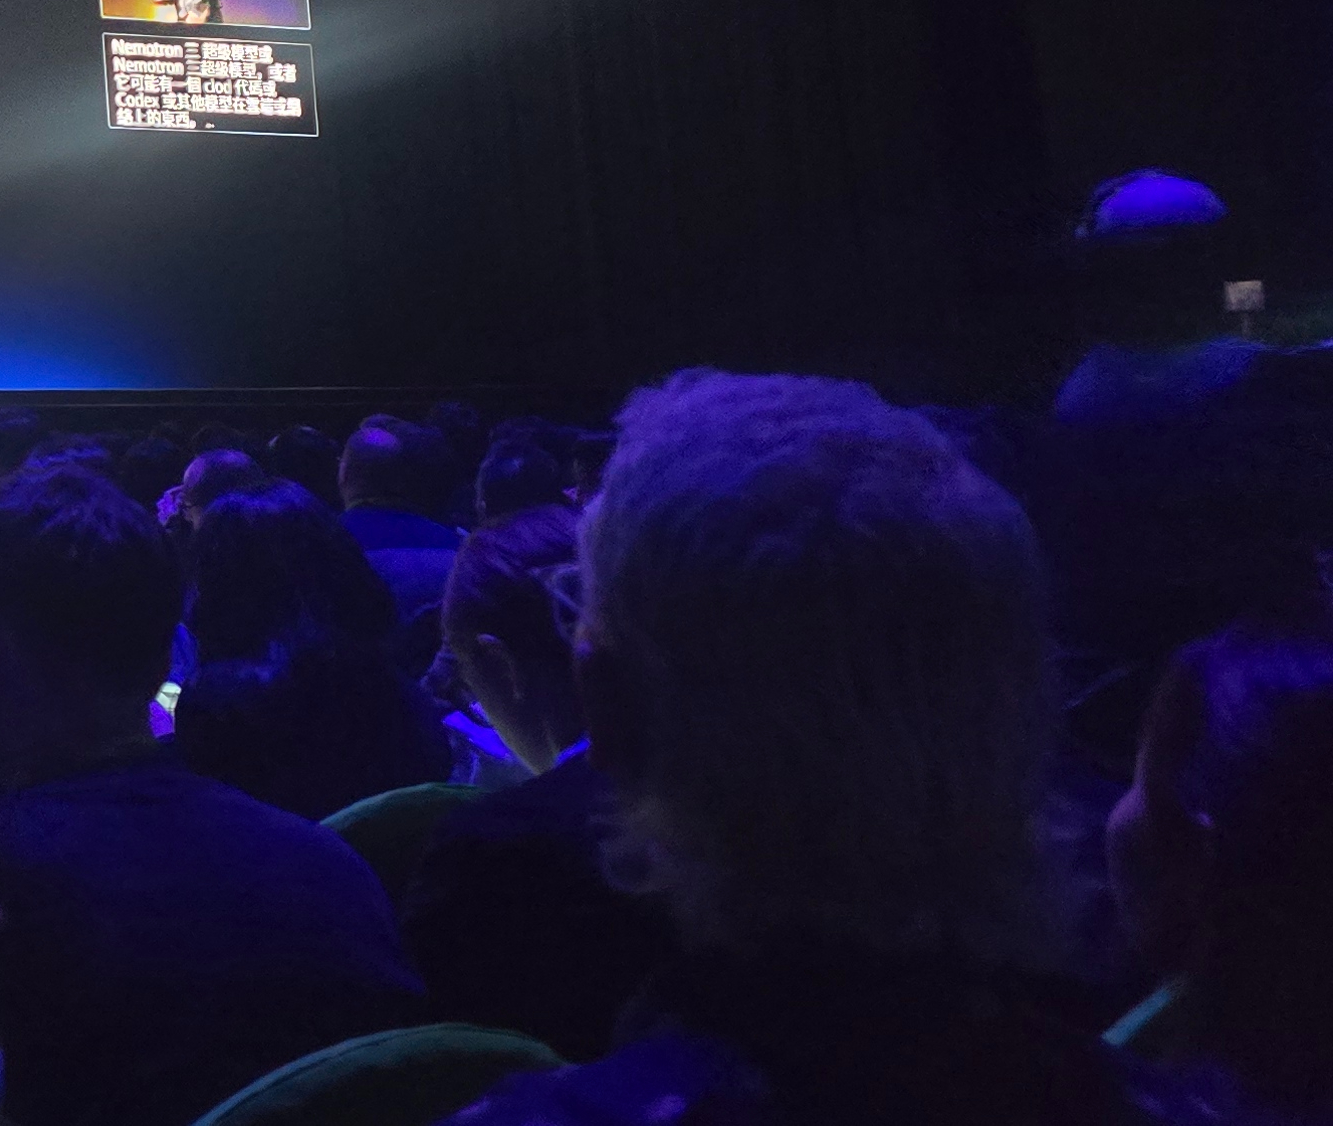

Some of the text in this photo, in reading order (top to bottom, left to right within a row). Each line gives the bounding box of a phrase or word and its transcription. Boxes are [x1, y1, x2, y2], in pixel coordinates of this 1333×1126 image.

[111, 38, 183, 58] Nemotron
[112, 57, 184, 75] Nemotron
[204, 77, 232, 94] clod
[115, 92, 160, 109] Codex
